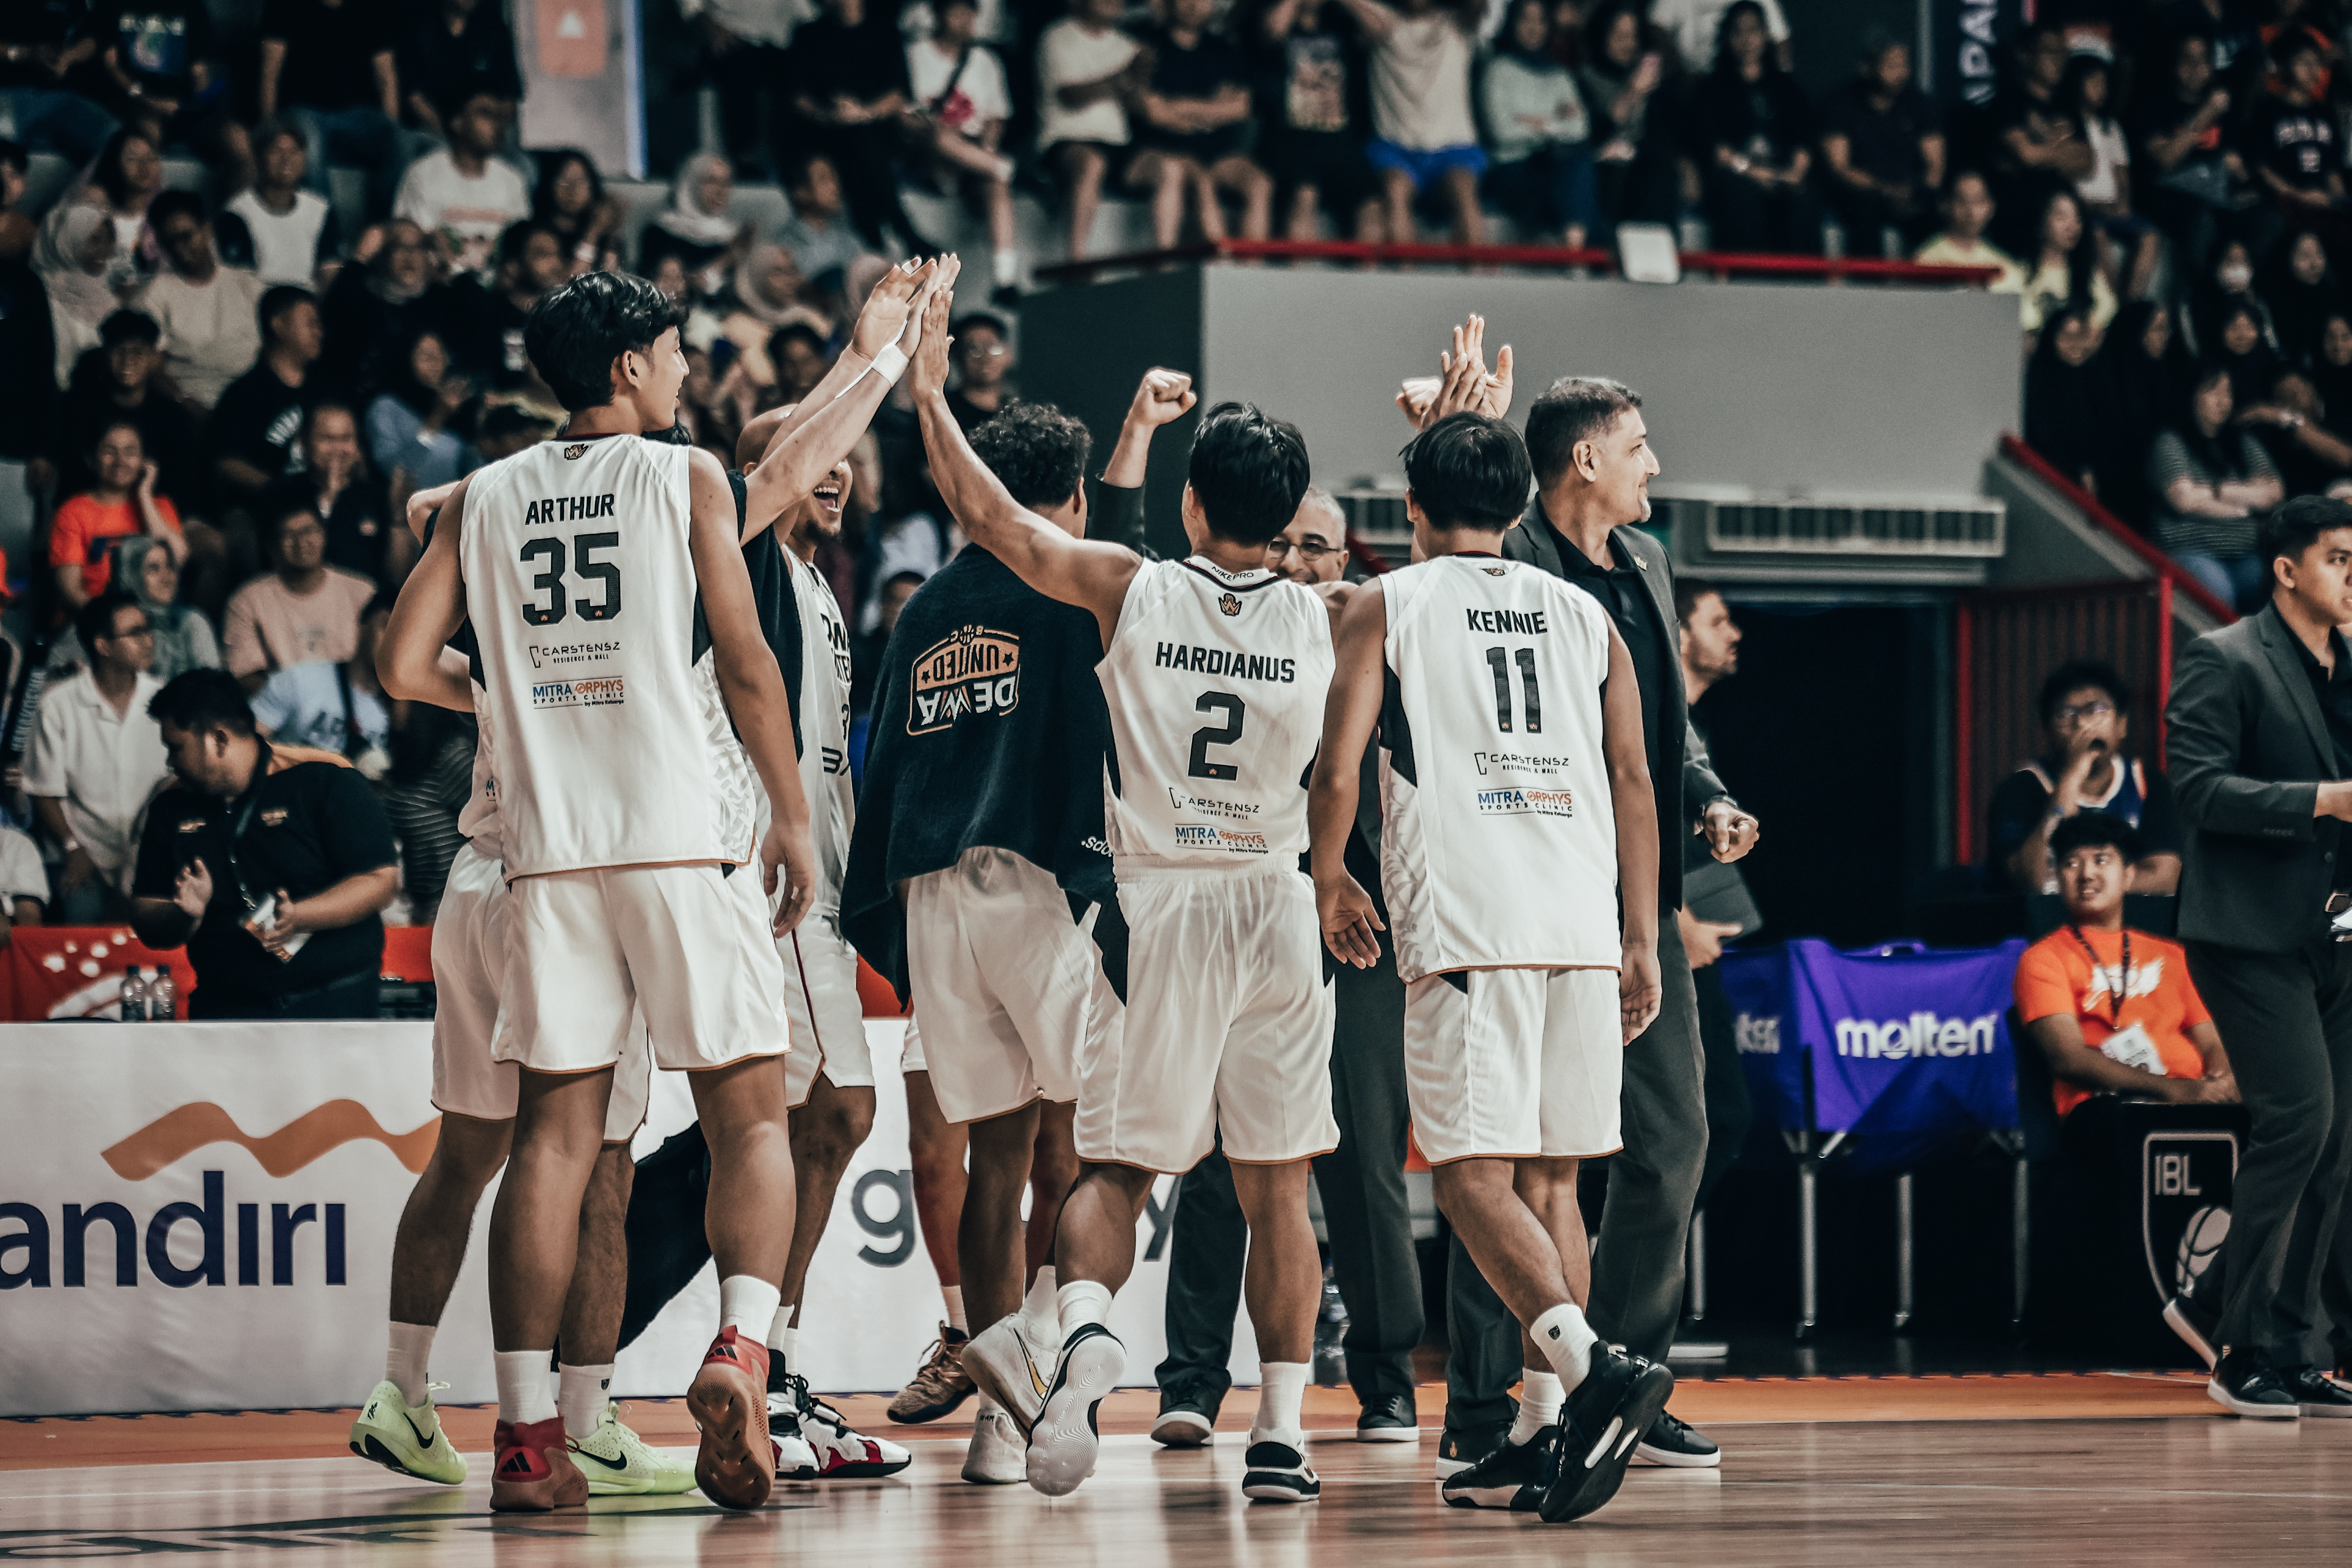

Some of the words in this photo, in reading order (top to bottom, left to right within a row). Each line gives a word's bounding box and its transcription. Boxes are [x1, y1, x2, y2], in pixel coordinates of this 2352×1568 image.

[524, 494, 614, 525] ARTHUR
[520, 532, 622, 626] 35
[1212, 566, 1232, 581] NIKE
[1466, 608, 1548, 635] KENNIE
[542, 642, 620, 656] CARSTENSZ
[933, 644, 999, 682] UNITED
[1156, 642, 1295, 683] HARDIANUS
[533, 684, 572, 697] MITRA
[575, 680, 623, 693] ORPHYS
[534, 695, 576, 704] SPORTS
[584, 692, 624, 700] CLINIC
[916, 676, 1016, 726] DEWA
[1486, 646, 1542, 734] 11
[1187, 691, 1246, 781] 2
[1490, 754, 1569, 766] CARSTENSZ
[1180, 796, 1259, 813] ARSTENSZ
[1478, 791, 1524, 804] MITRA
[1527, 791, 1572, 805] ORPHYS
[1175, 827, 1216, 839] MITRA
[1220, 831, 1265, 843] ORPHYS
[1835, 1011, 1998, 1060] molten
[2154, 1154, 2201, 1196] IBL
